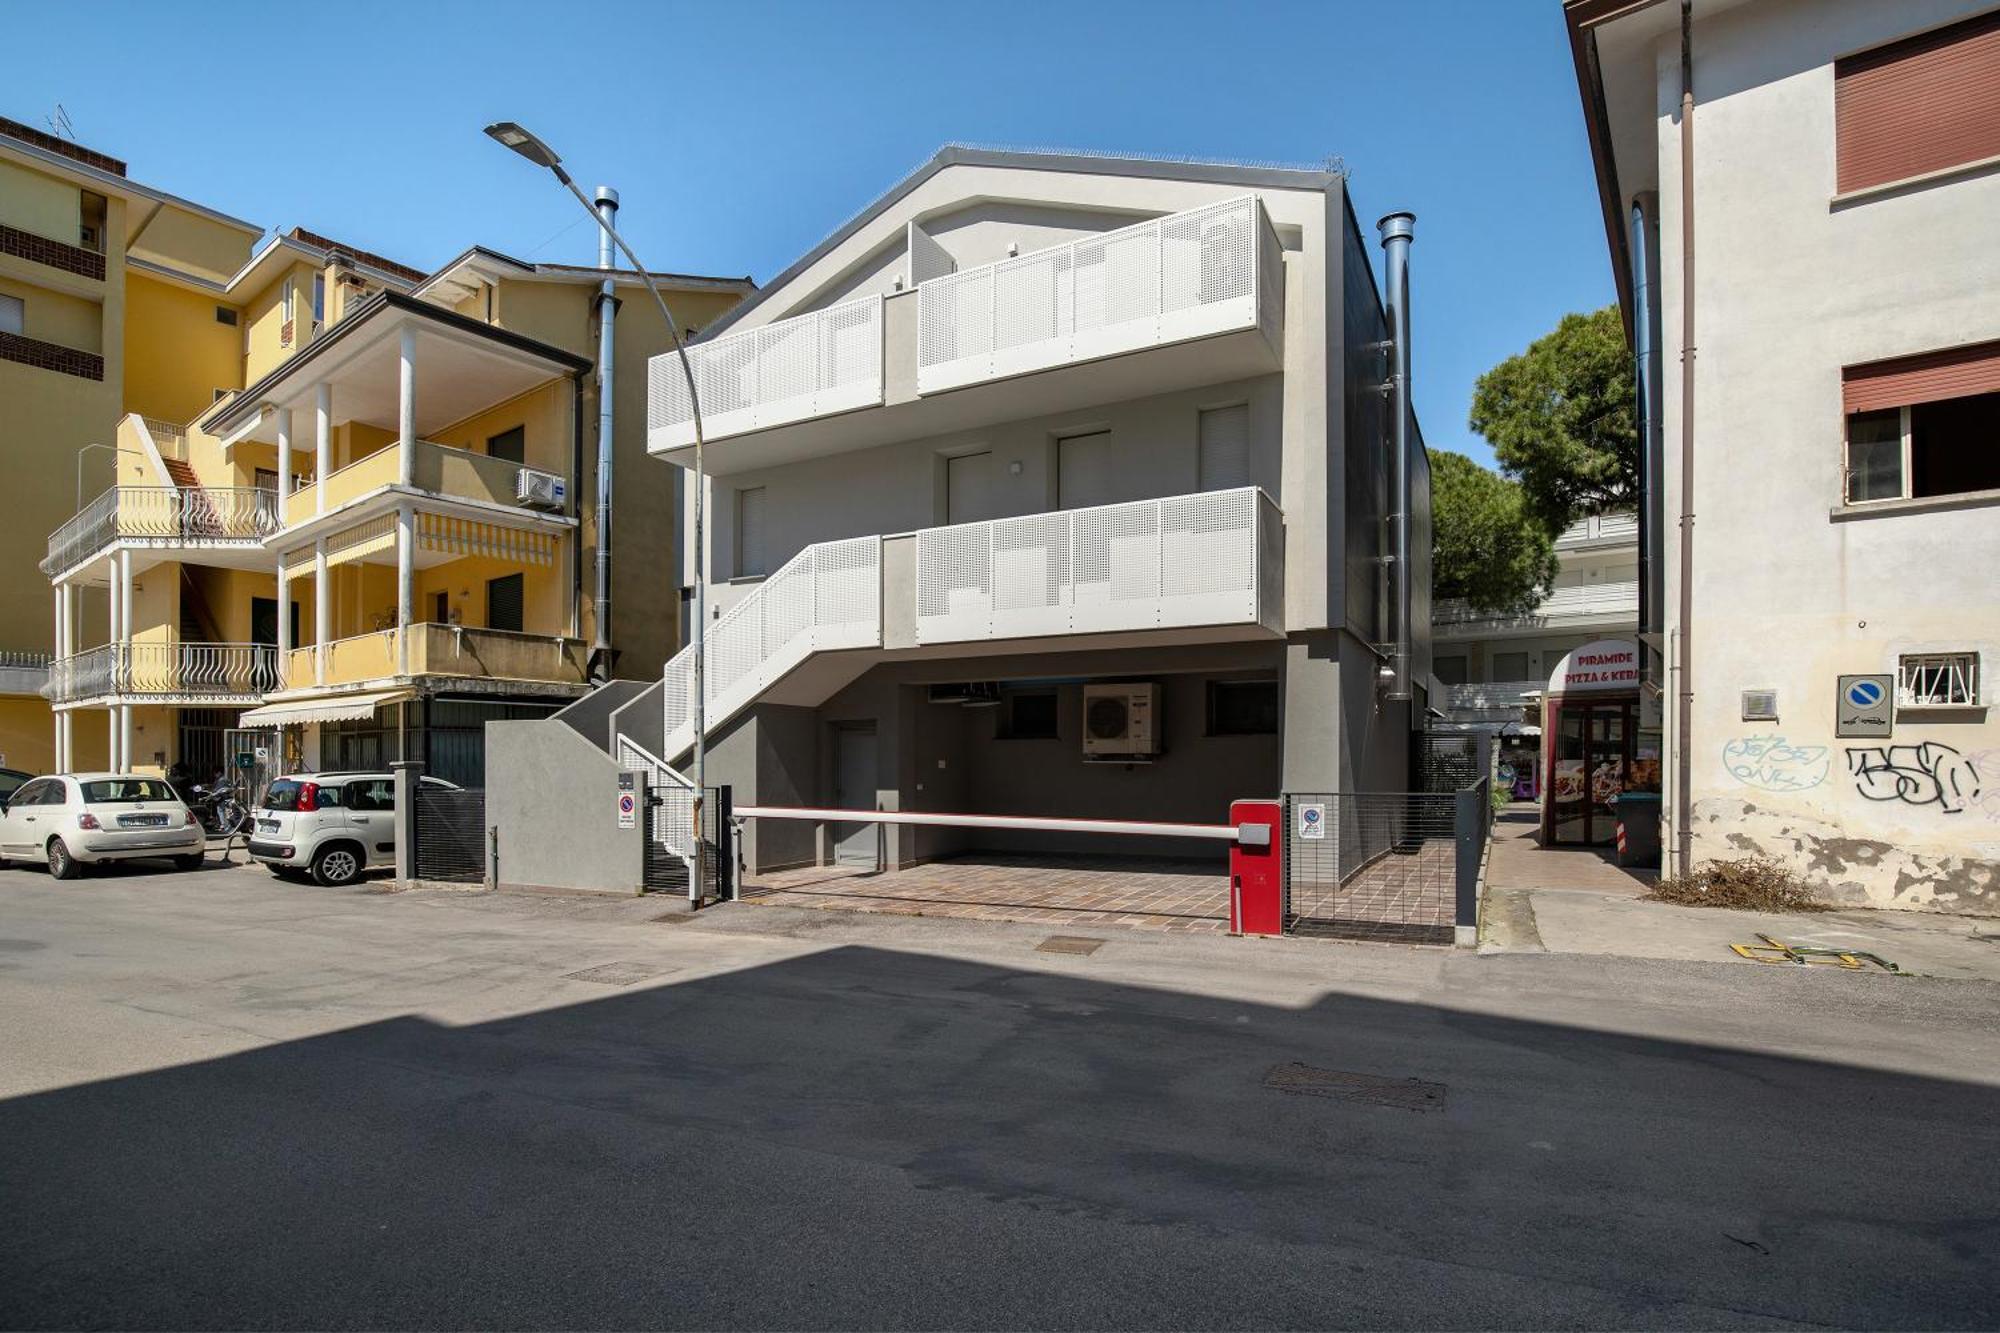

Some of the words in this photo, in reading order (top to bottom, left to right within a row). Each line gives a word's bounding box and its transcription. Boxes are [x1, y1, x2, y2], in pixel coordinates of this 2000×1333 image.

[1578, 652, 1633, 666] PIRAMIDE
[1565, 671, 1598, 684] PIZZA
[1601, 671, 1609, 682] &
